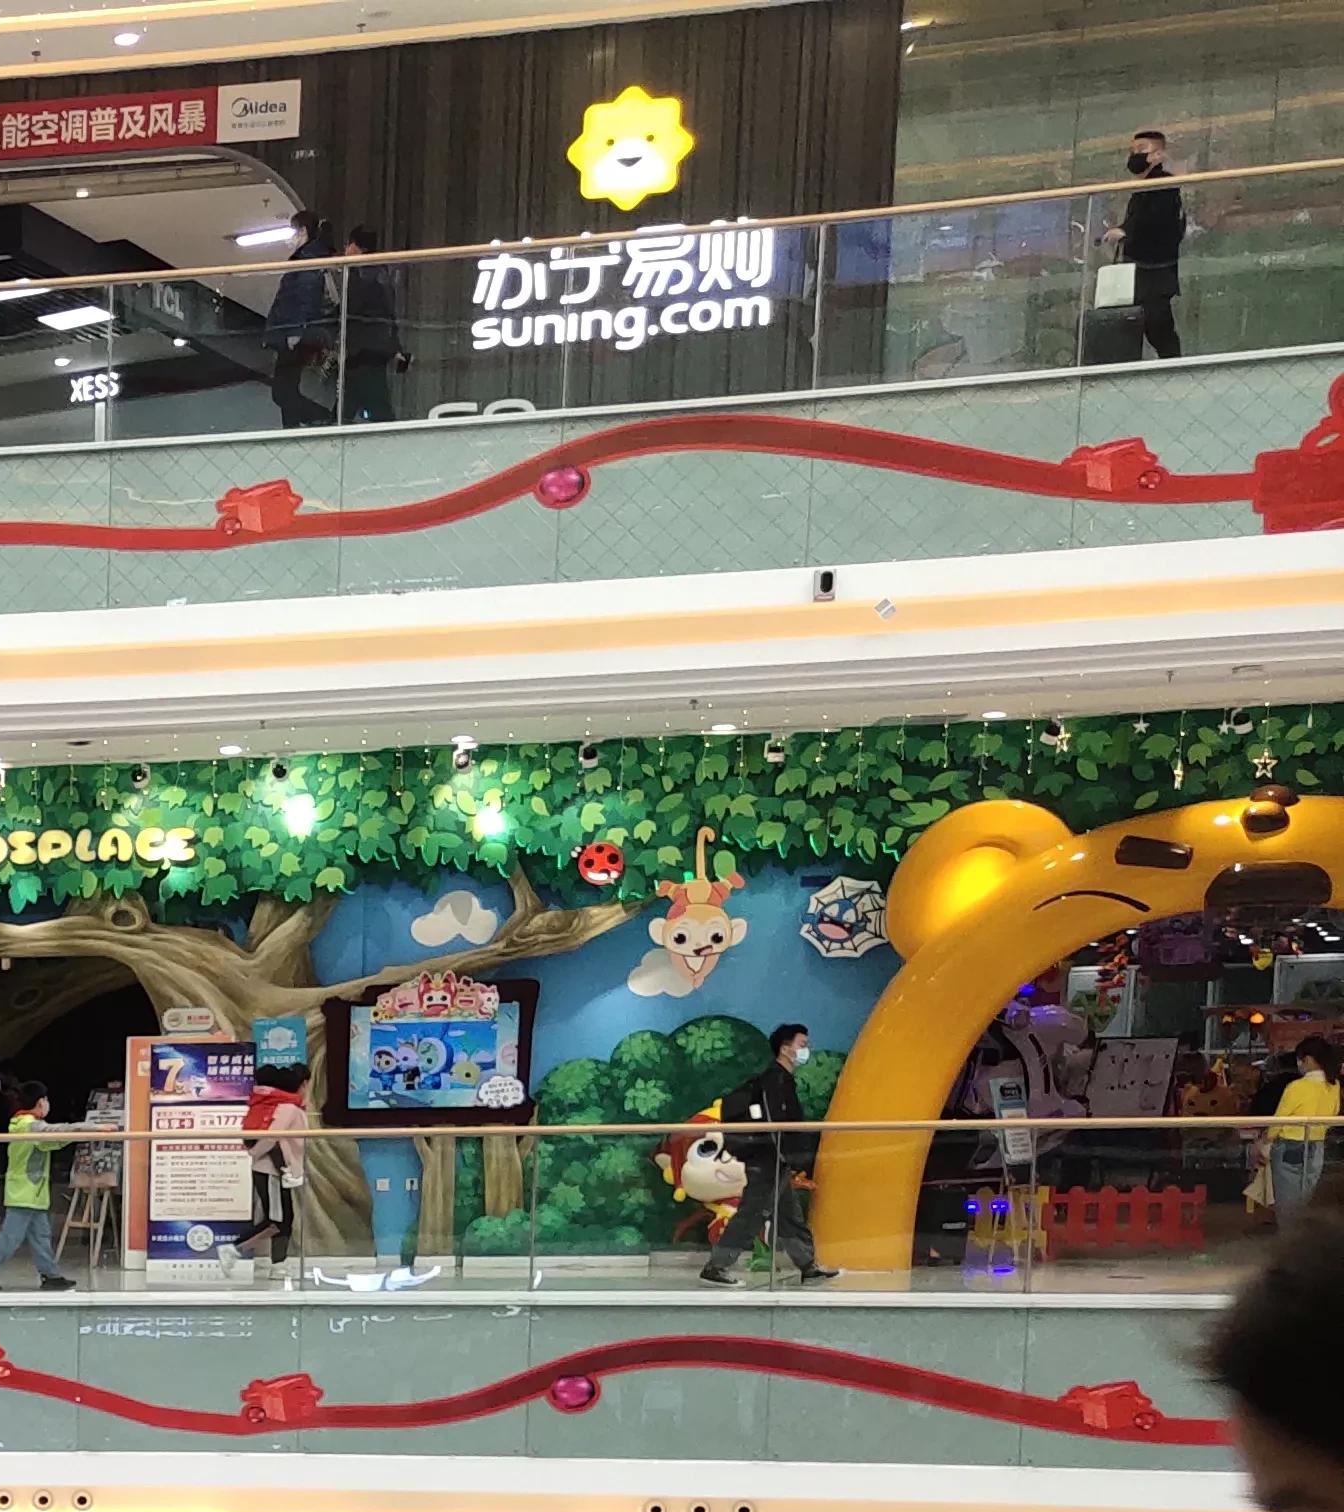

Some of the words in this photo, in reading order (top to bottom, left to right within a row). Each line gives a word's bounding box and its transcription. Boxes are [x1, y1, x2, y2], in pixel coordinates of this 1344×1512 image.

[231, 96, 287, 118] Midea
[472, 217, 774, 311] 苏宁易购
[471, 296, 771, 351] suning.com
[70, 371, 120, 402] XESS
